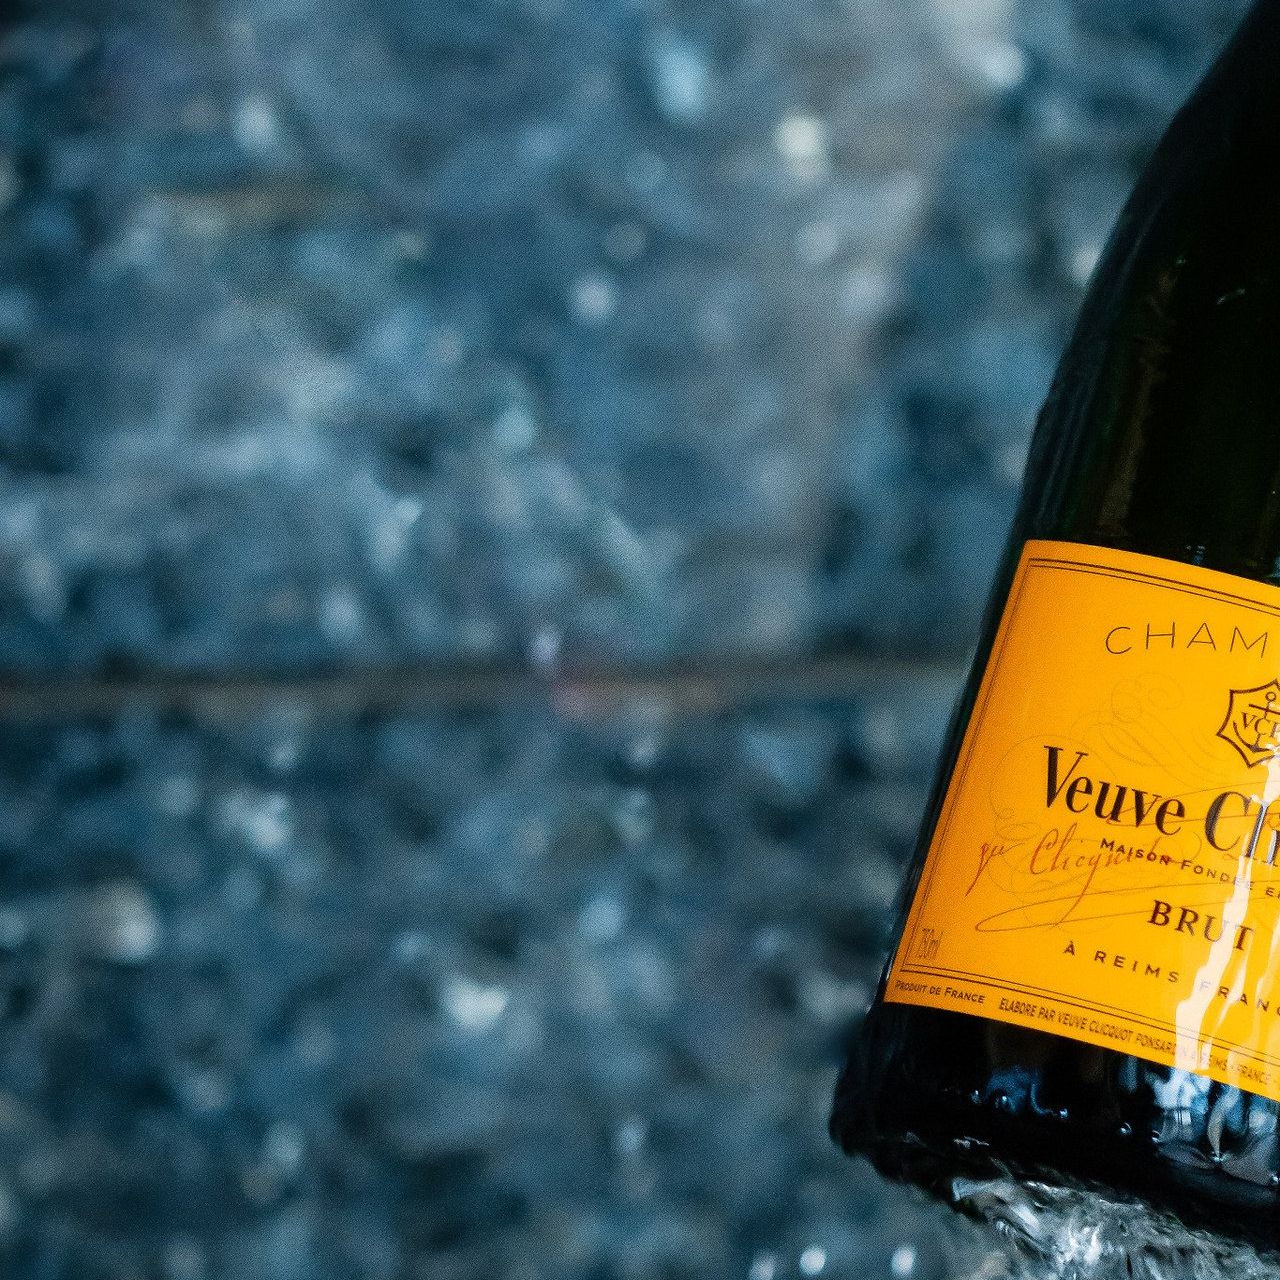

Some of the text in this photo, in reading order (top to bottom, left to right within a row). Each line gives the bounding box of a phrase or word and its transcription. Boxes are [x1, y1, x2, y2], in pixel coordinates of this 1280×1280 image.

[1043, 744, 1187, 836] Veuve
[1099, 837, 1170, 866] MAISON
[1147, 899, 1255, 951] BRUT
[1094, 950, 1181, 983] REIMS
[895, 979, 986, 1004] PRODUIT DE FRANCE
[1057, 1011, 1089, 1030] VEUVE
